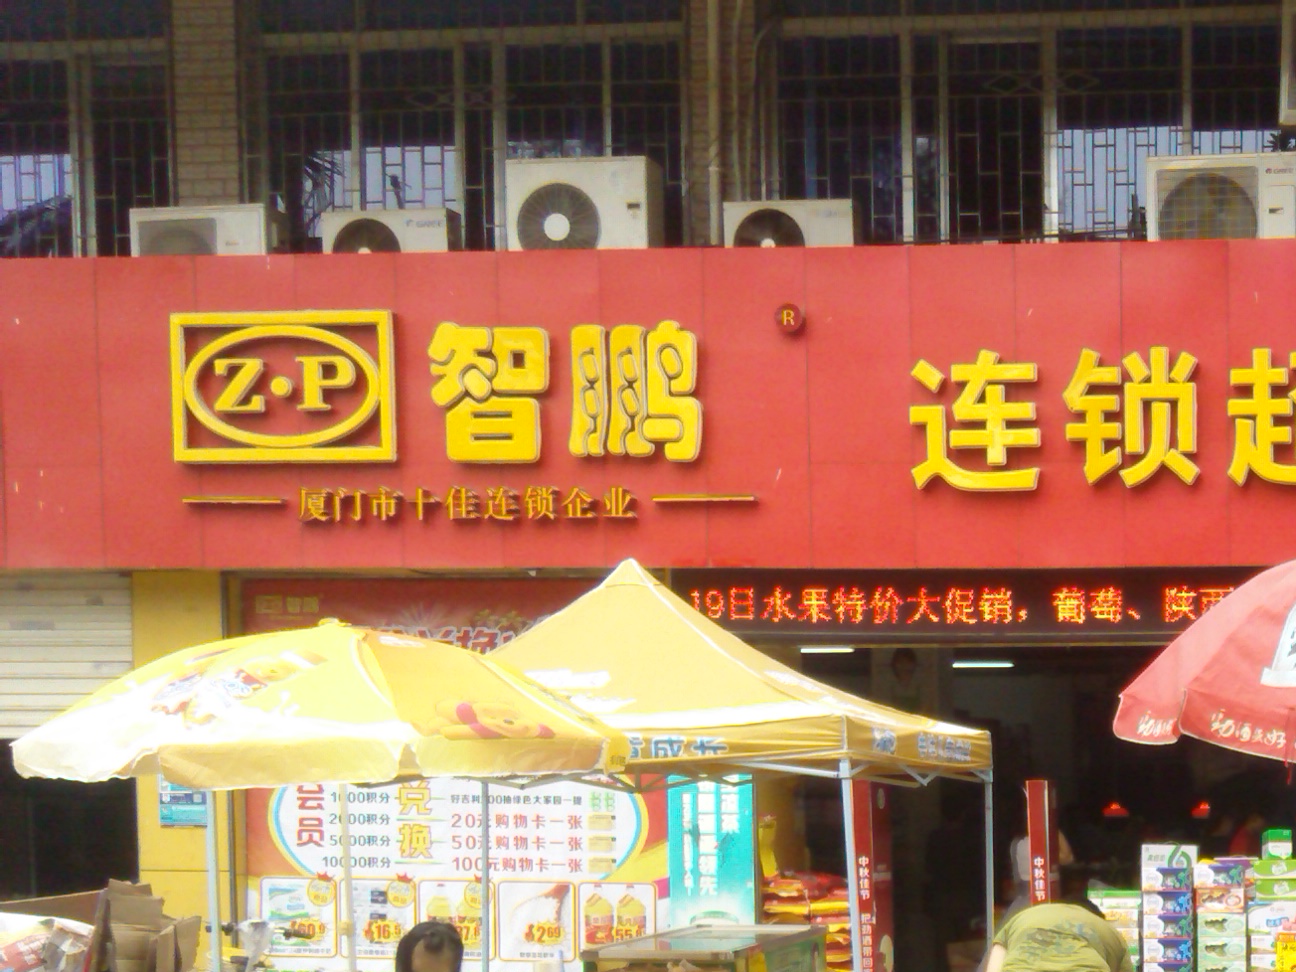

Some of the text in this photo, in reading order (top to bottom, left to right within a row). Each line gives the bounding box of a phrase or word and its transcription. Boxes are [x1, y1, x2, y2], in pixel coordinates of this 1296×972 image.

[428, 319, 704, 464] 智鹏
[299, 487, 638, 521] 厦门市十佳连锁企业
